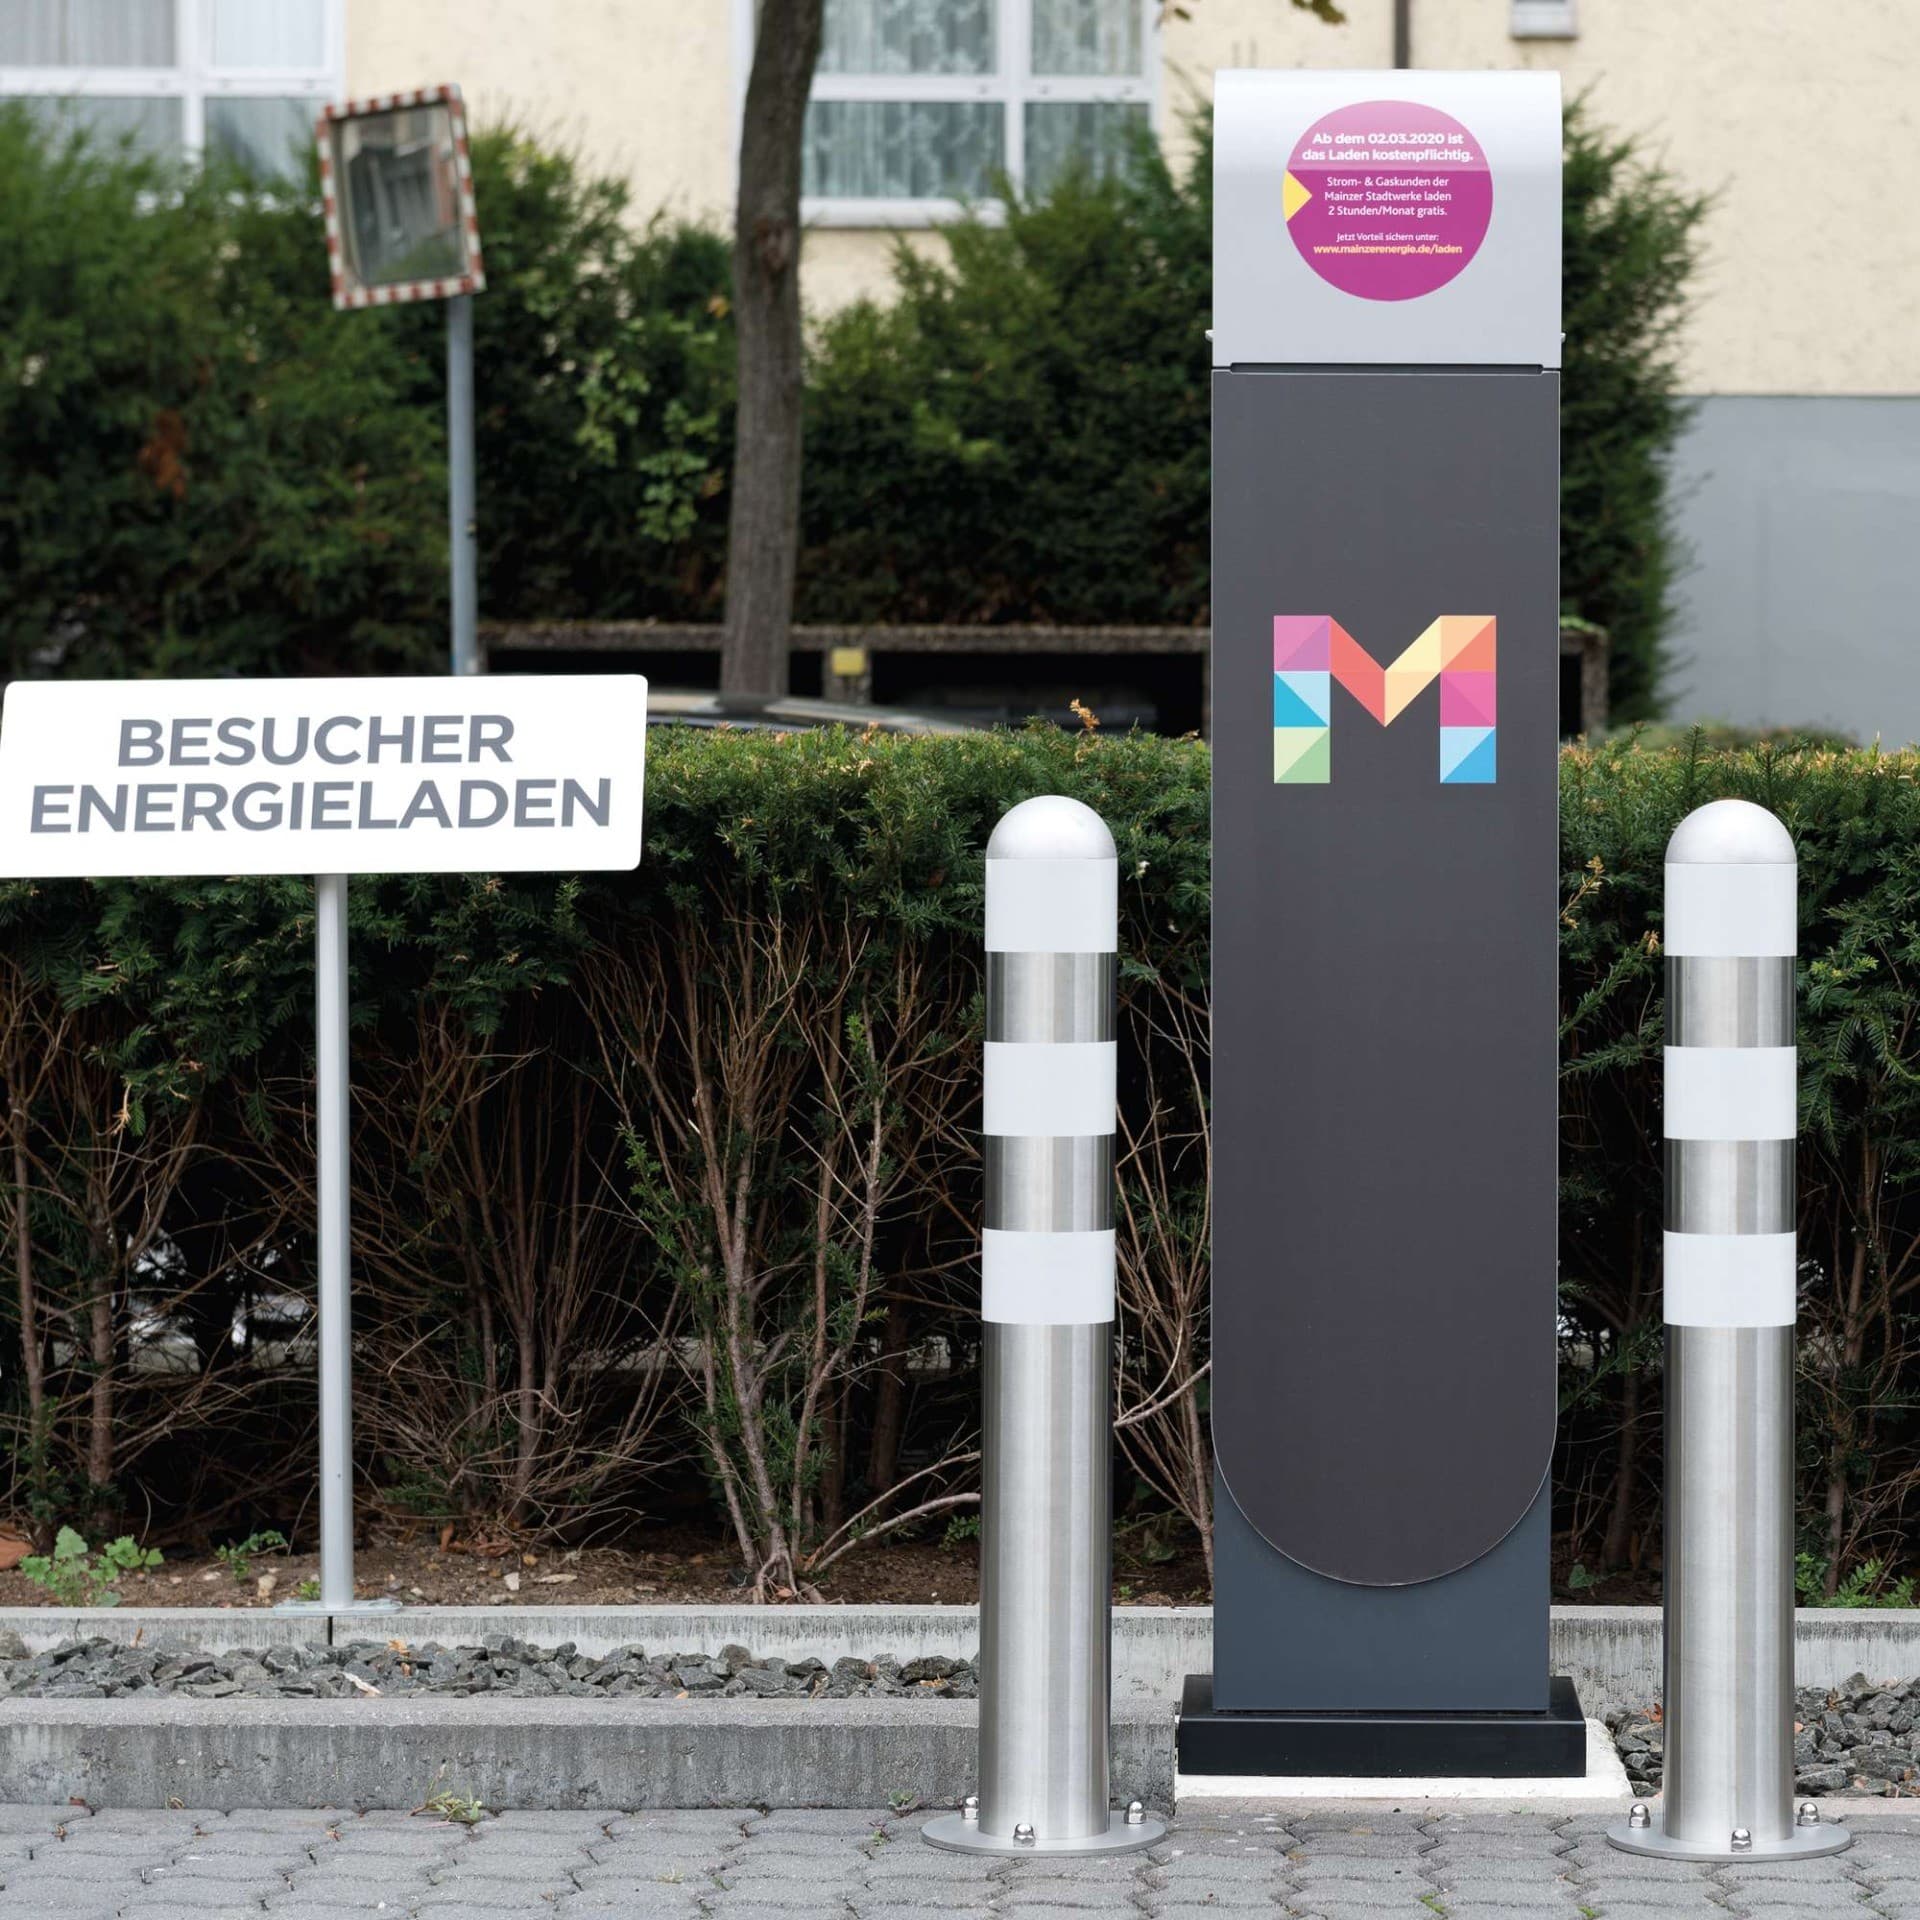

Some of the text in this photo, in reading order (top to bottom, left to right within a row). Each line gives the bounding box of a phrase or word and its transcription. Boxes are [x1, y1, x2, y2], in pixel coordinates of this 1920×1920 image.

[1312, 133, 1332, 145] Ab
[1335, 133, 1365, 145] dem
[1447, 133, 1464, 145] ist
[1302, 149, 1474, 163] das Laden kostenpflichtig.
[1326, 176, 1449, 187] Strom- & Gaskunden der
[1324, 191, 1452, 201] Mainzer Stadtwerke laden
[1328, 205, 1448, 218] 2 Stunden/Monat gratis.
[1336, 232, 1439, 242] Jetzt Vorteil sichern unter:
[1313, 244, 1463, 256] www.mainzerenergie.de/laden
[1273, 615, 1497, 784] M
[118, 714, 515, 767] BESUCHER
[30, 777, 612, 833] ENERGIELADEN
